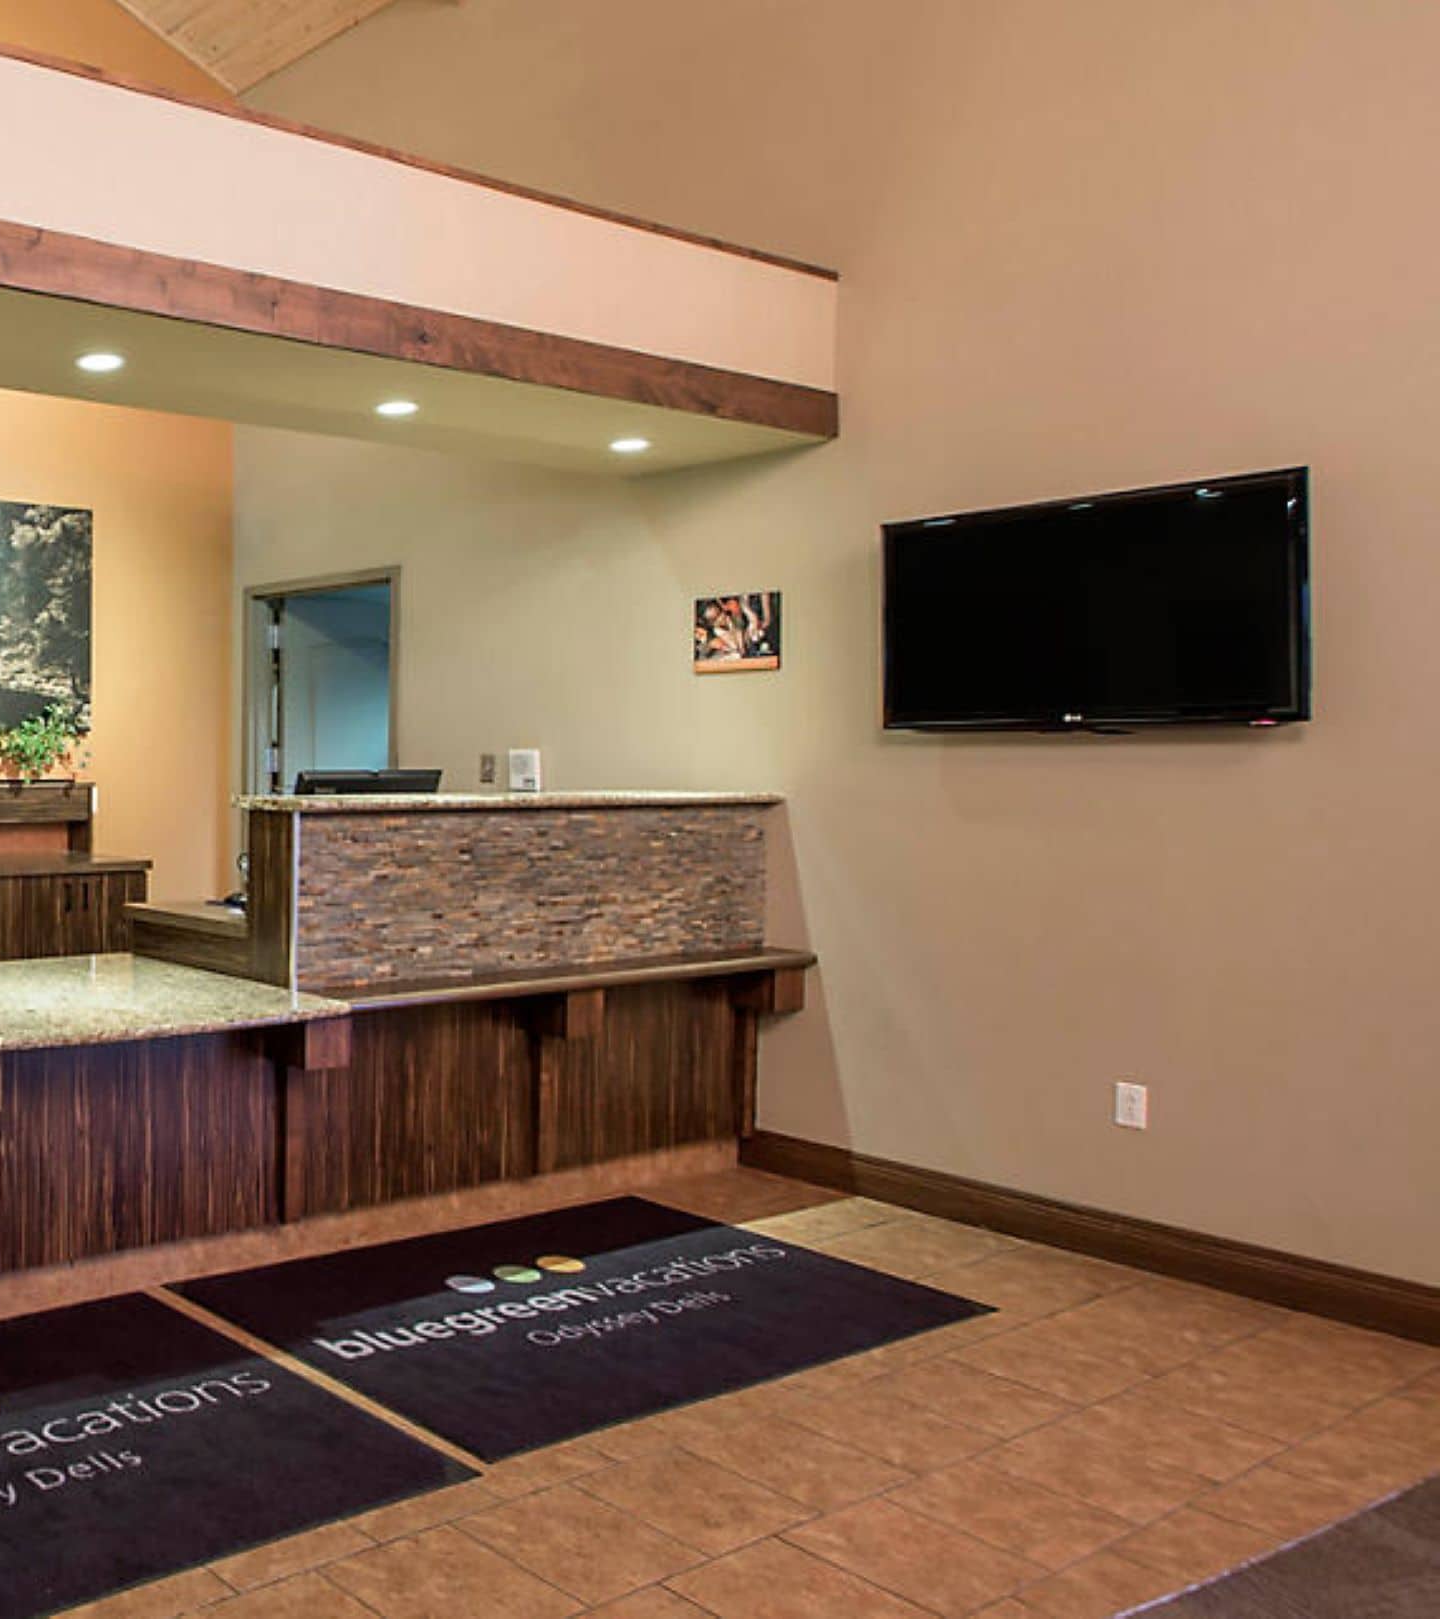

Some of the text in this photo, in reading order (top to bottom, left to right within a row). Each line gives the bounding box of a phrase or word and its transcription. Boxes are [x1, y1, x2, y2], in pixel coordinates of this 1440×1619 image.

[526, 1290, 732, 1346] Odyssey Dells
[24, 1449, 143, 1491] Dells
